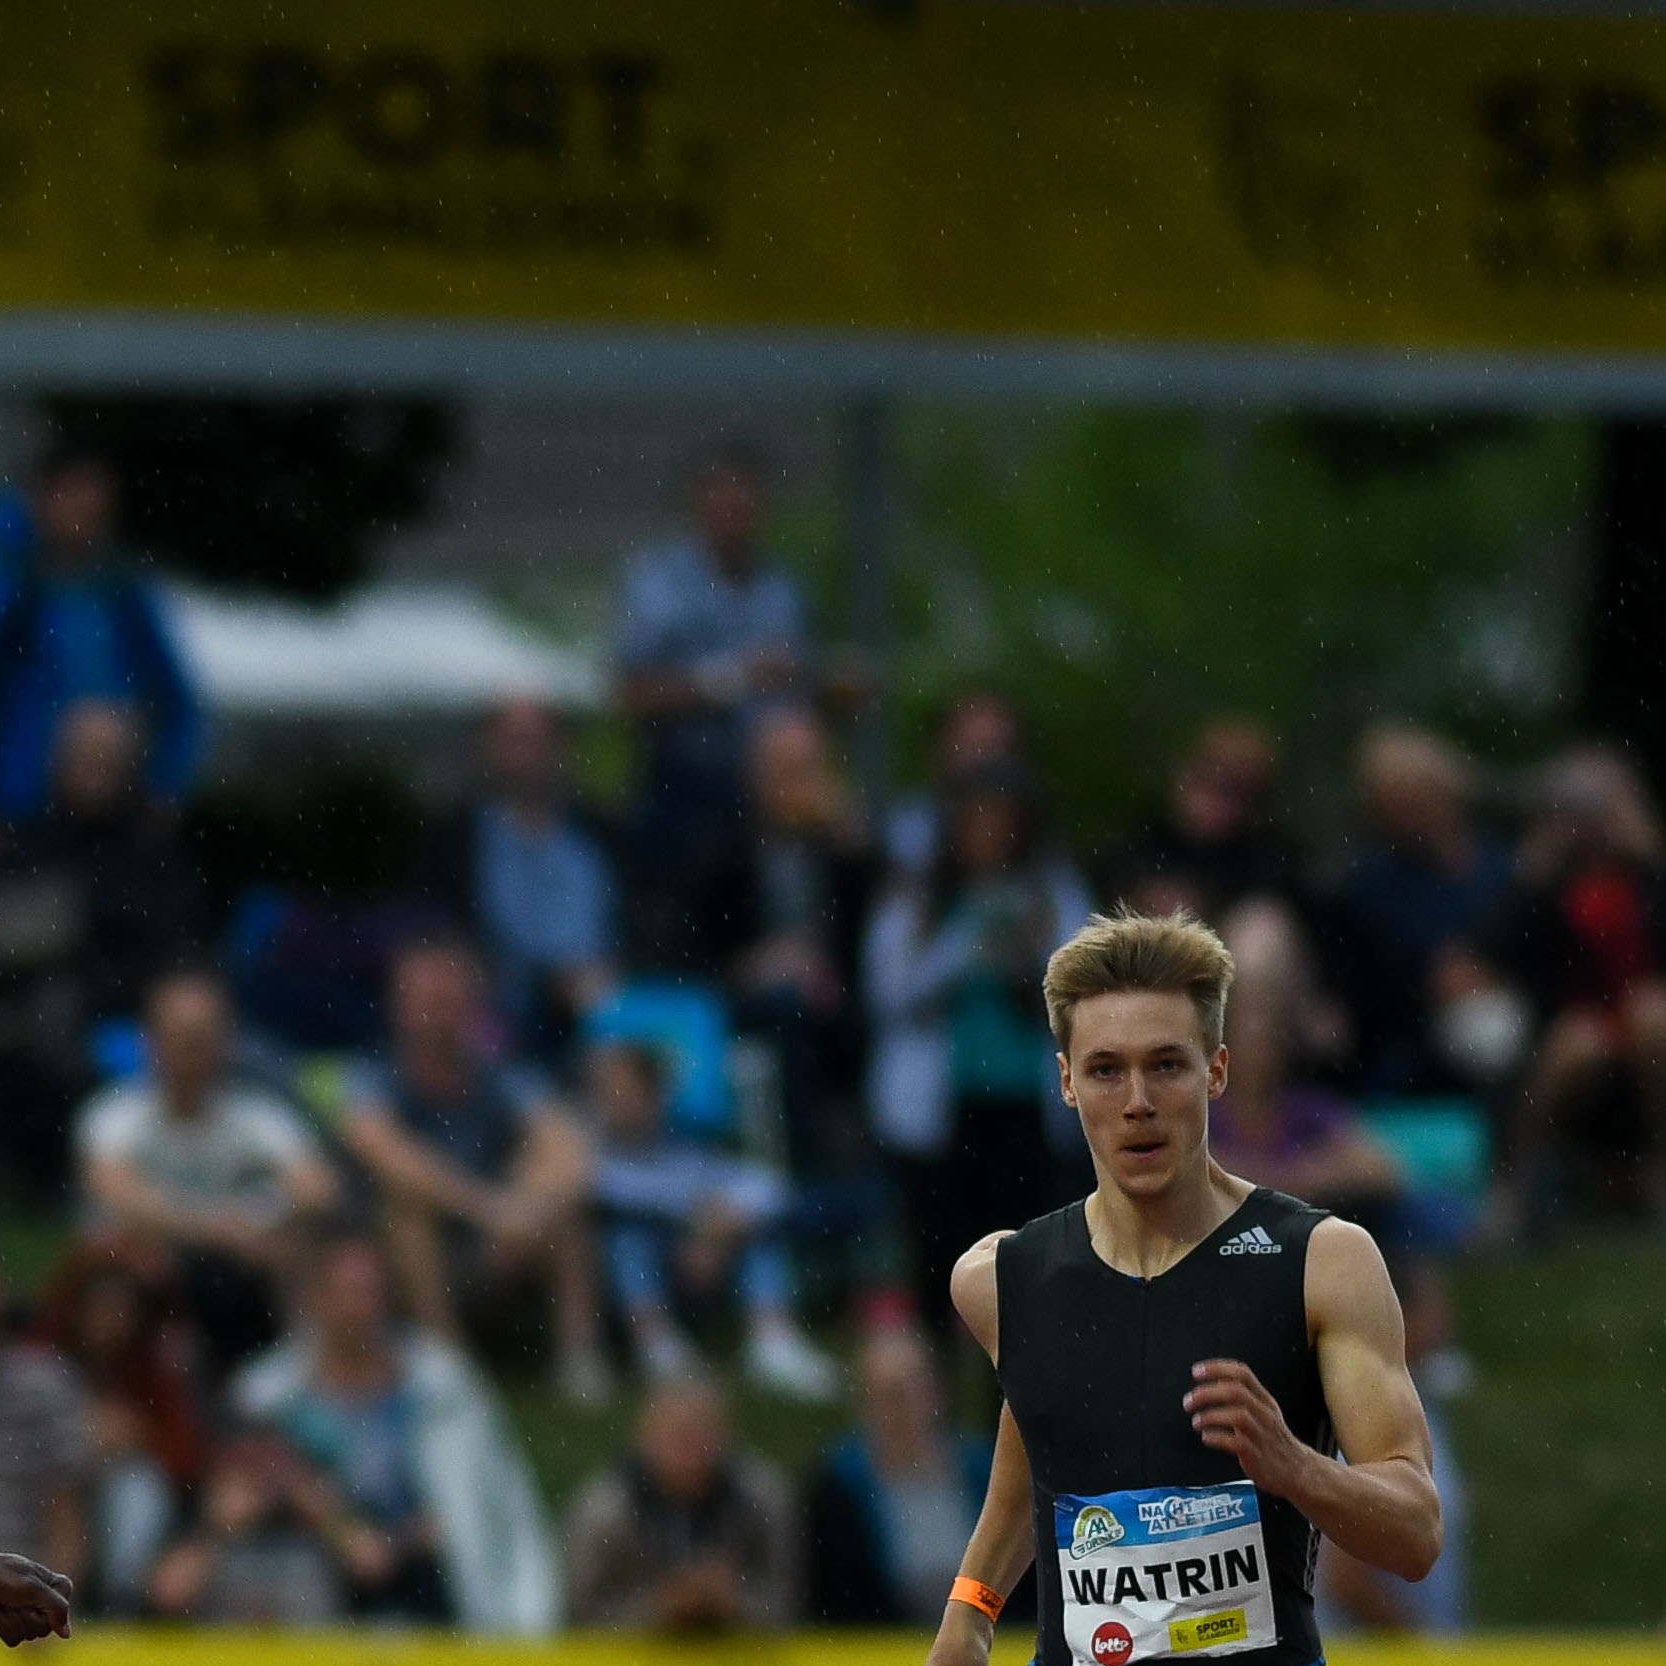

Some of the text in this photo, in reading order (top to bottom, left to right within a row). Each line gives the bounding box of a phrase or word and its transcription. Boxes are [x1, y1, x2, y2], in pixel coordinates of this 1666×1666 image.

[1219, 1243, 1282, 1255] adidas
[1087, 1516, 1109, 1539] AA
[1151, 1504, 1240, 1532] ATLETIEK
[1068, 1544, 1261, 1606] WATRIN
[1196, 1618, 1240, 1634] SPORT.
